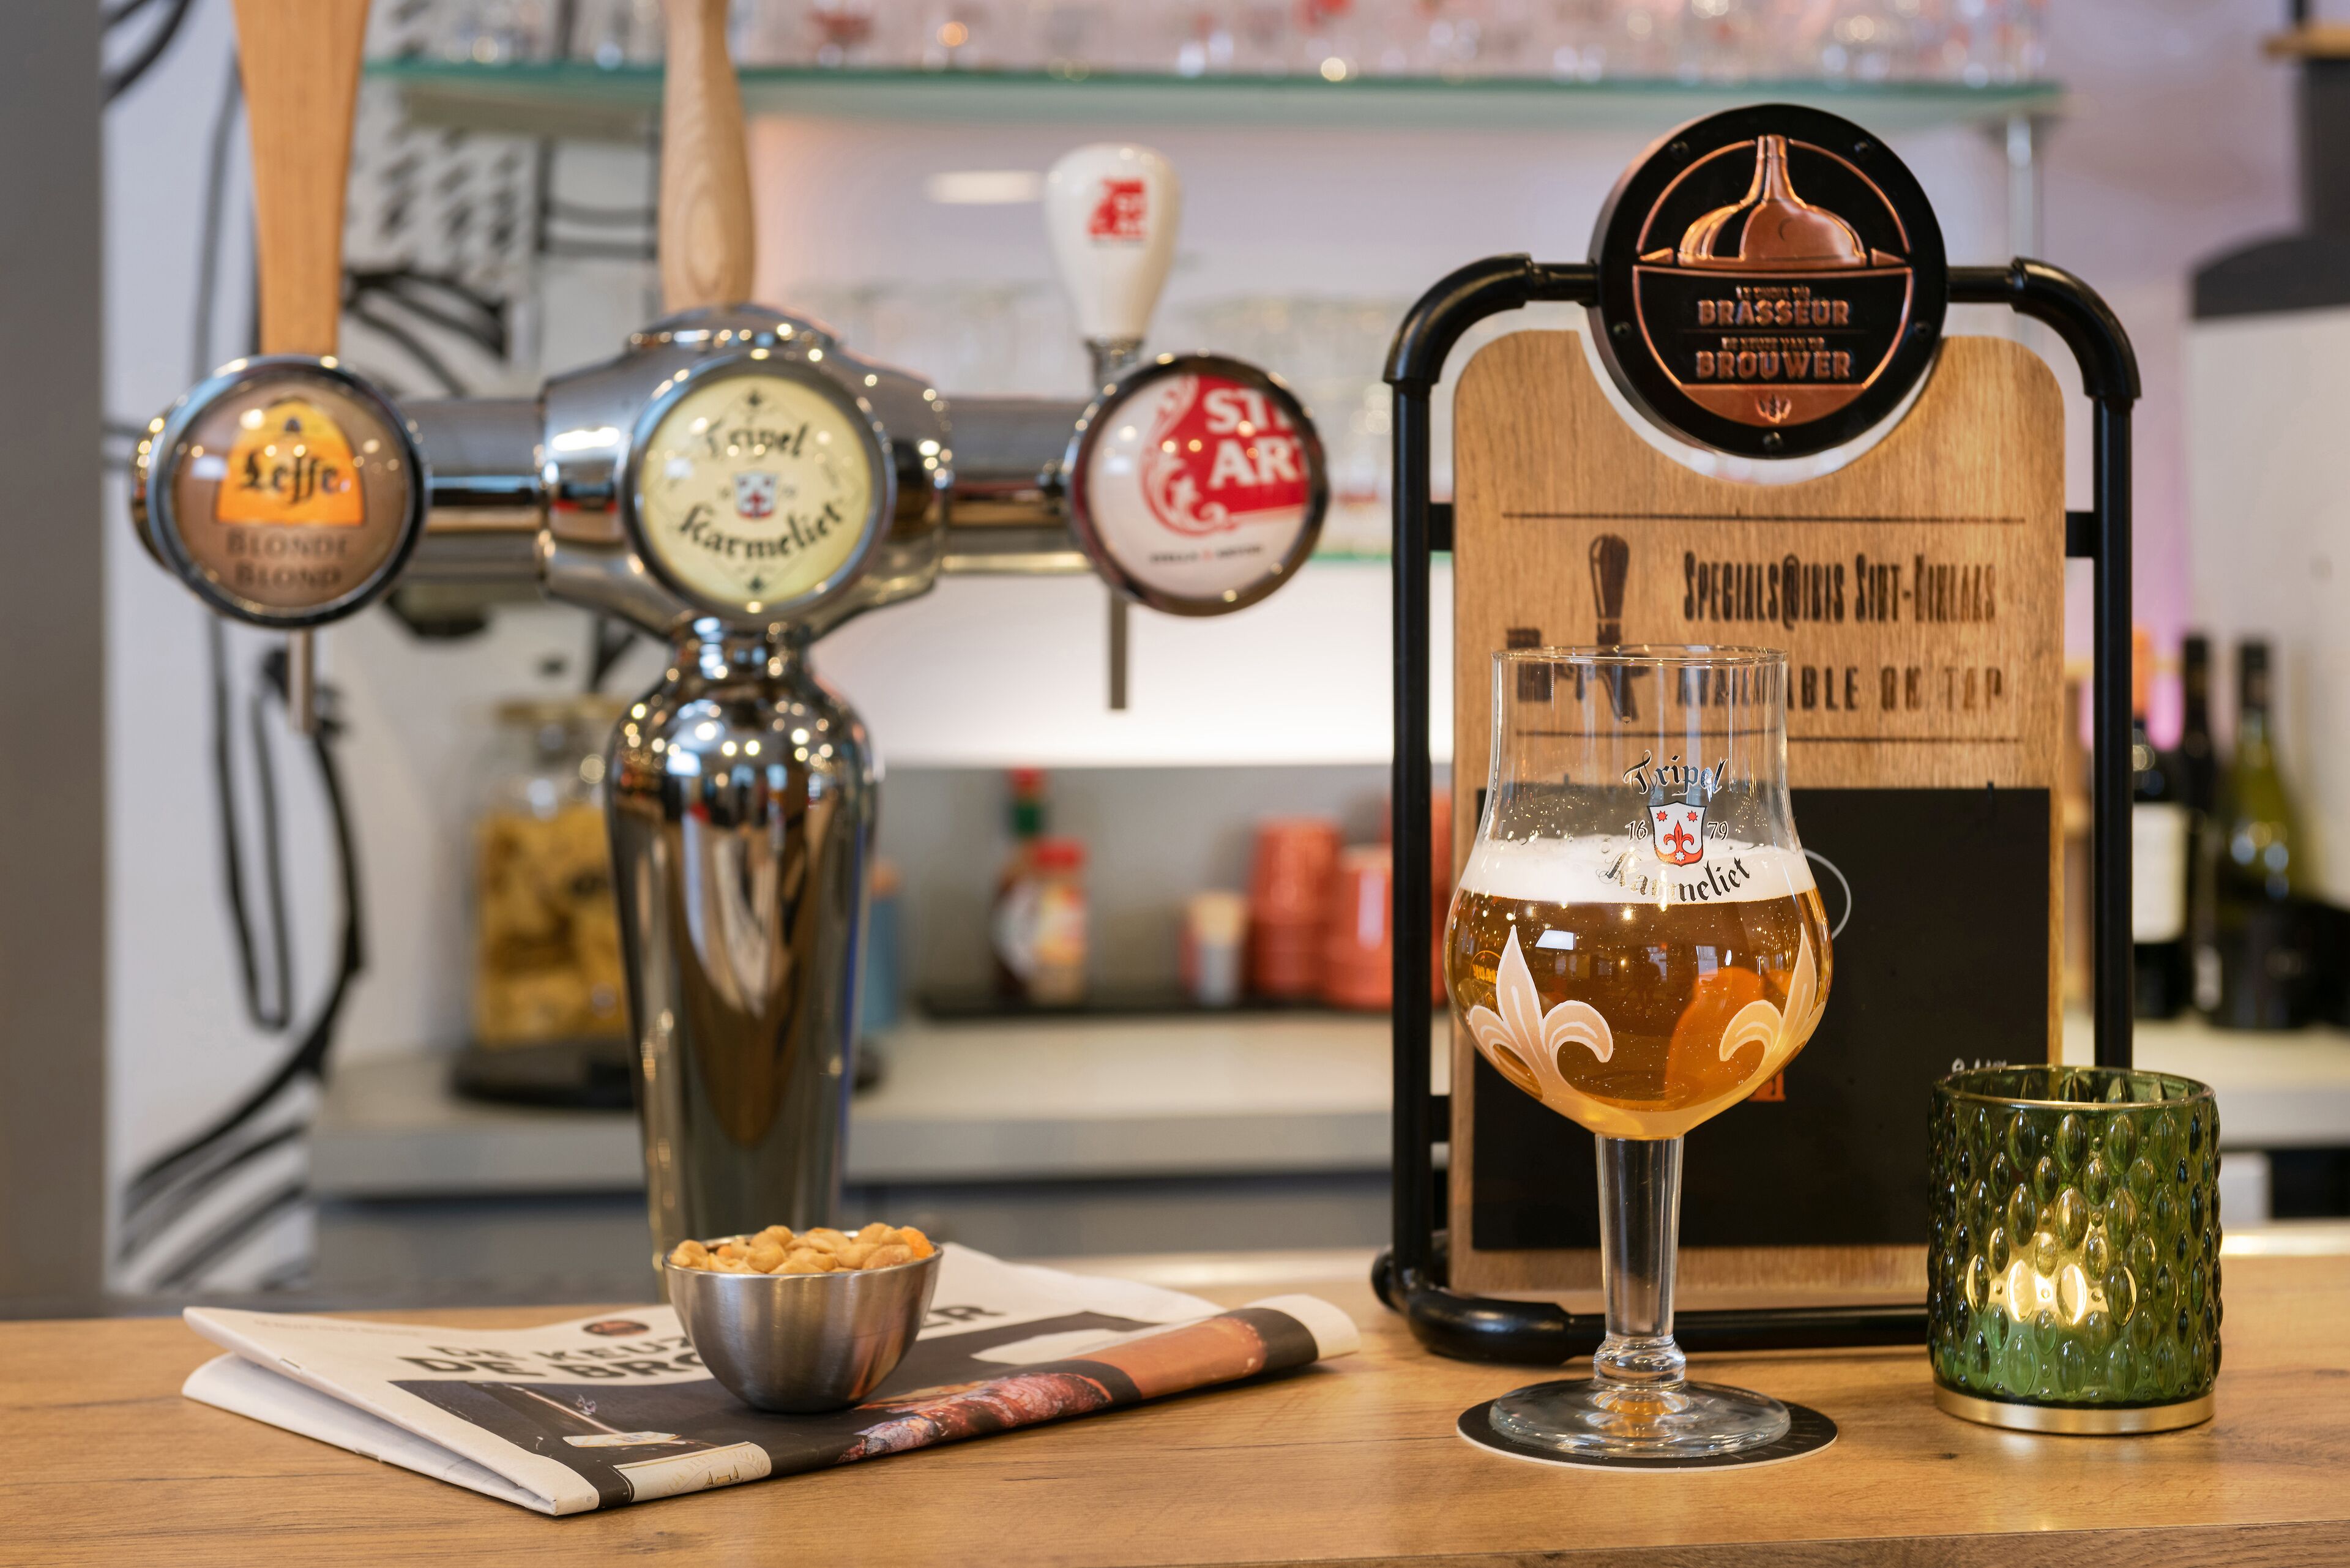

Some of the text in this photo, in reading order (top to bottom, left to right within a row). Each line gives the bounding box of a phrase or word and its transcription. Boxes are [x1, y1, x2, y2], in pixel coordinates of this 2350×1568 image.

[1697, 299, 1849, 326] BRASSEUR
[1696, 350, 1851, 380] BROUWER
[705, 417, 809, 460] Tripel
[239, 449, 340, 506] Leffe
[678, 501, 843, 559] Karmeliet
[1623, 749, 1728, 796] Tripel
[1625, 819, 1729, 842] 16 79
[1596, 850, 1750, 902] Karmeliet
[395, 1356, 548, 1377] DE
